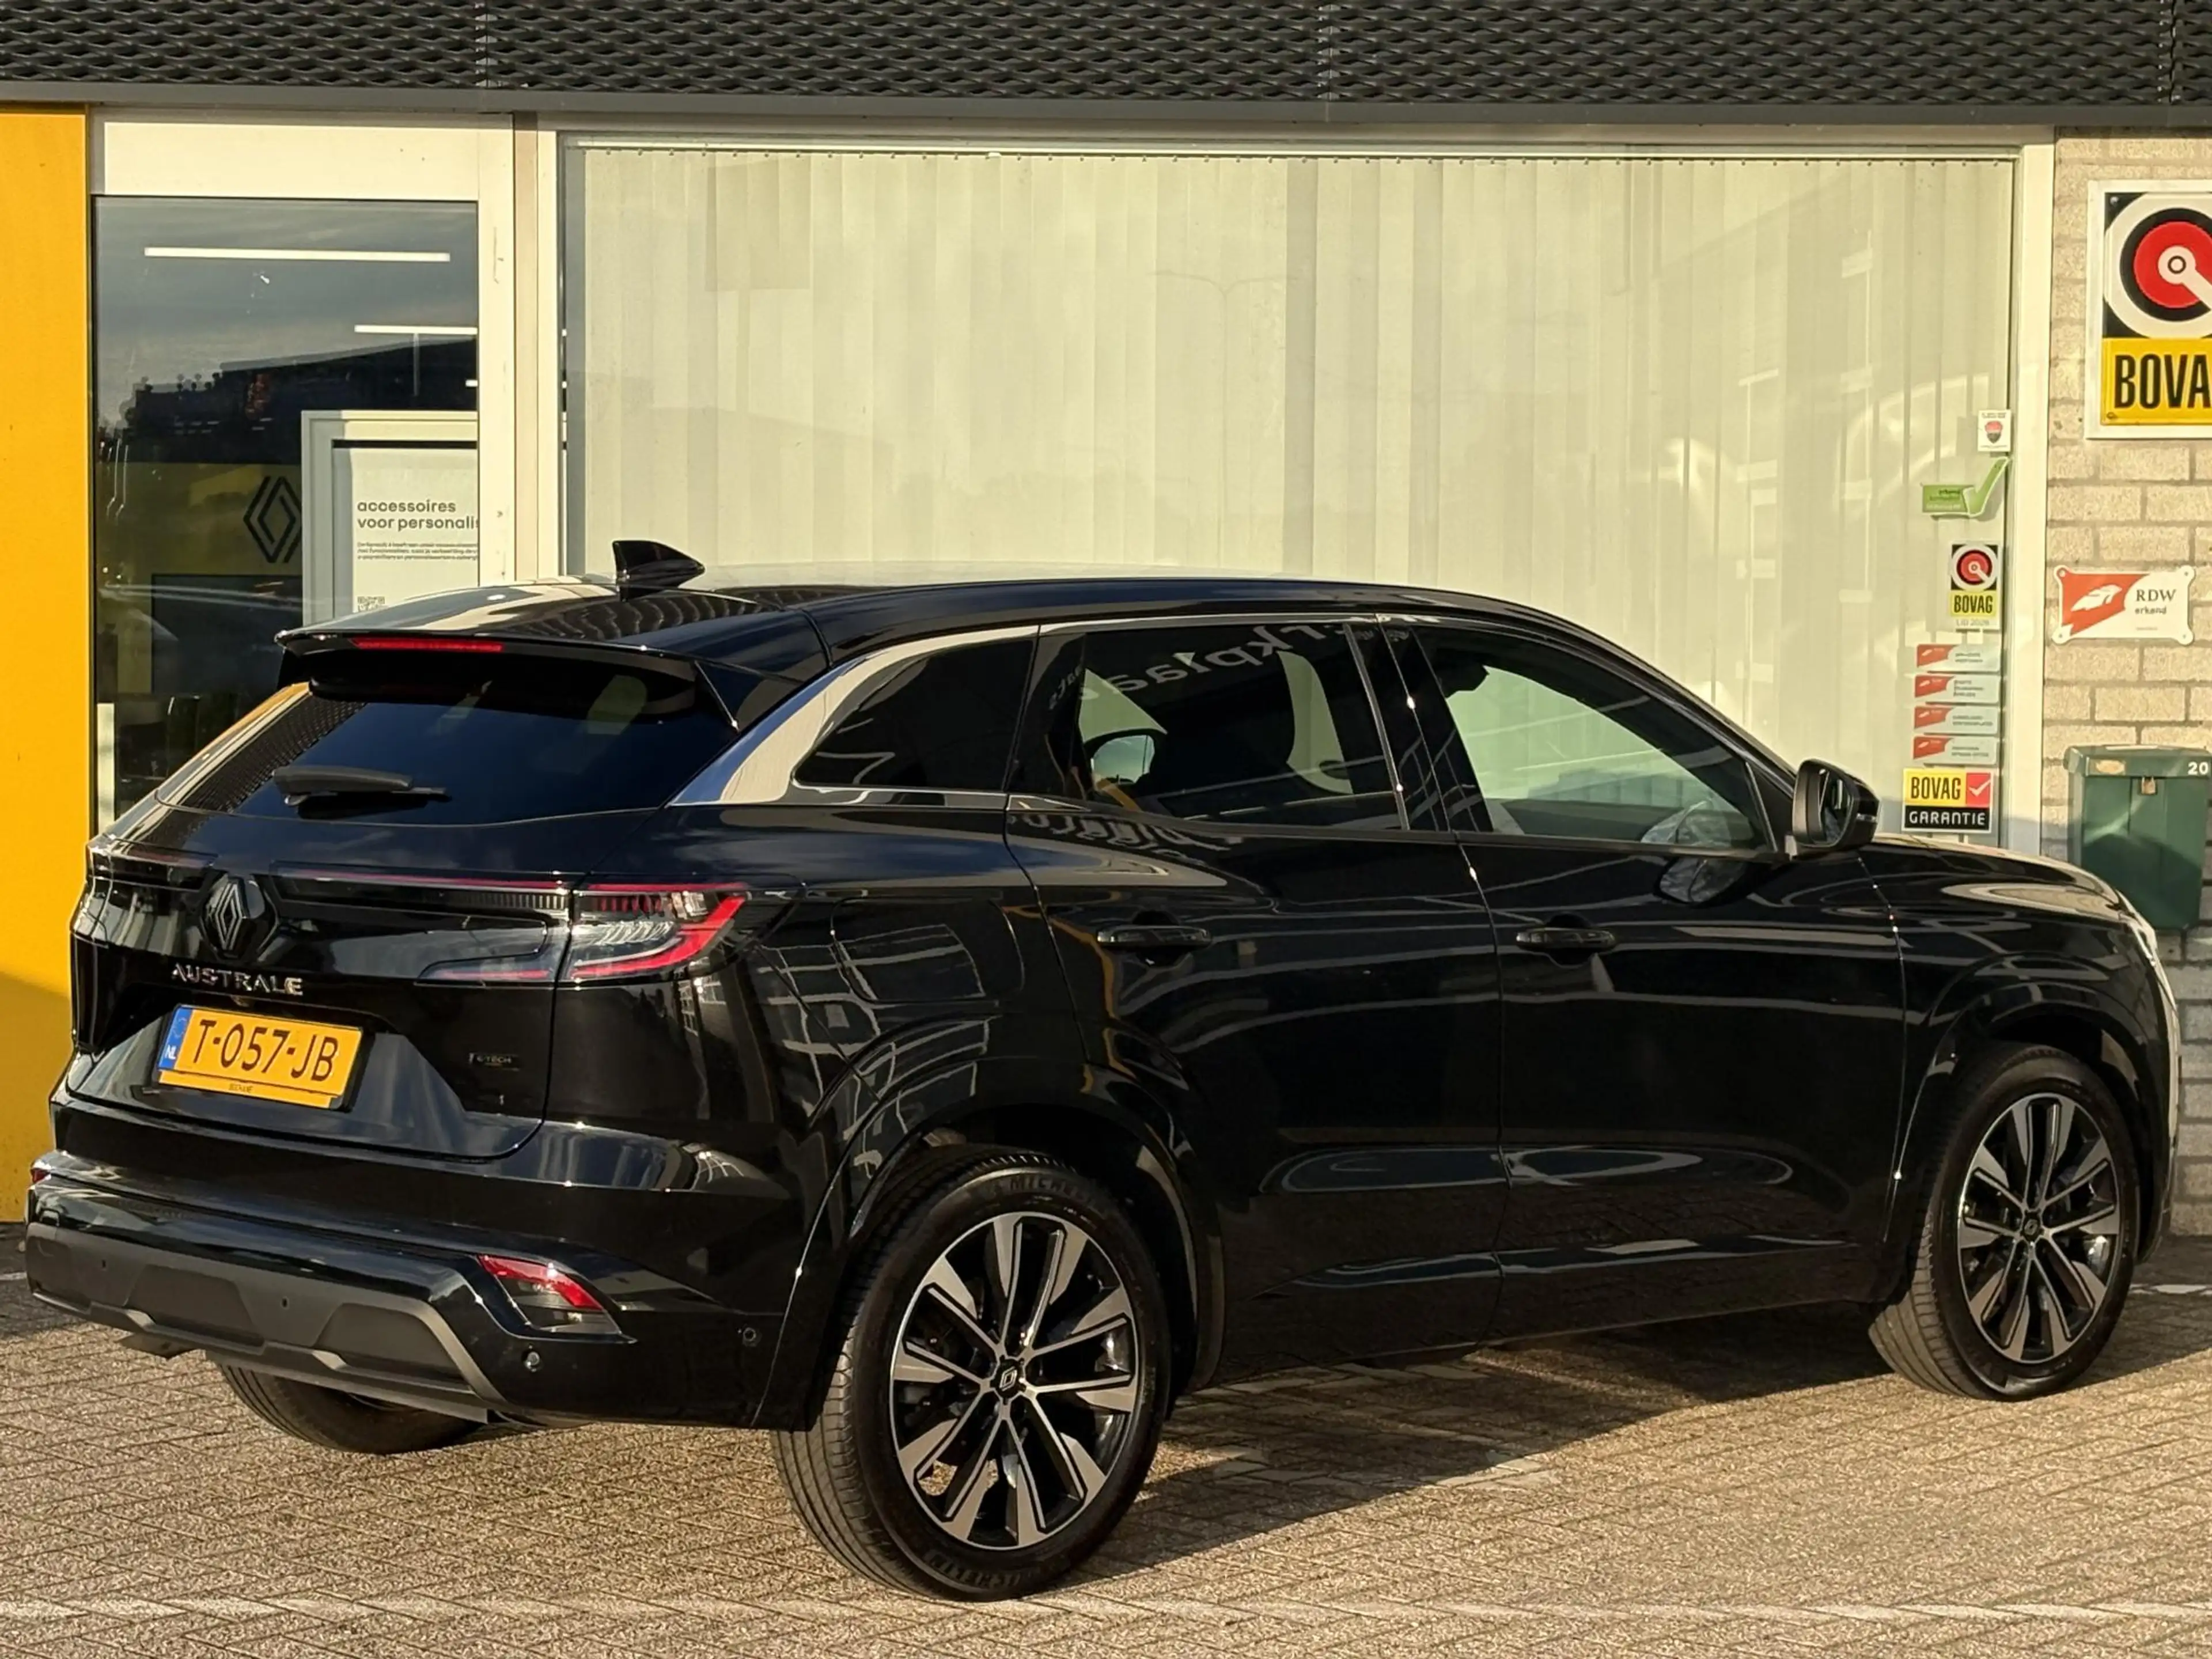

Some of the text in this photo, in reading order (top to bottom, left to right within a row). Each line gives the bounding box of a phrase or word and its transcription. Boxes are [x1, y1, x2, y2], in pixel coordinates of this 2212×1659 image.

[2115, 354, 2211, 409] BOVA
[357, 499, 456, 513] accessoires
[358, 518, 395, 529] voor
[2136, 589, 2176, 602] RDW
[1954, 594, 1993, 613] BOVAG
[2135, 605, 2167, 615] erkend
[2187, 762, 2209, 775] 20
[1911, 777, 1961, 800] BOVAG
[1909, 811, 1986, 825] GARANTIE
[164, 1044, 176, 1060] NL
[193, 1019, 339, 1082] T-057-JB
